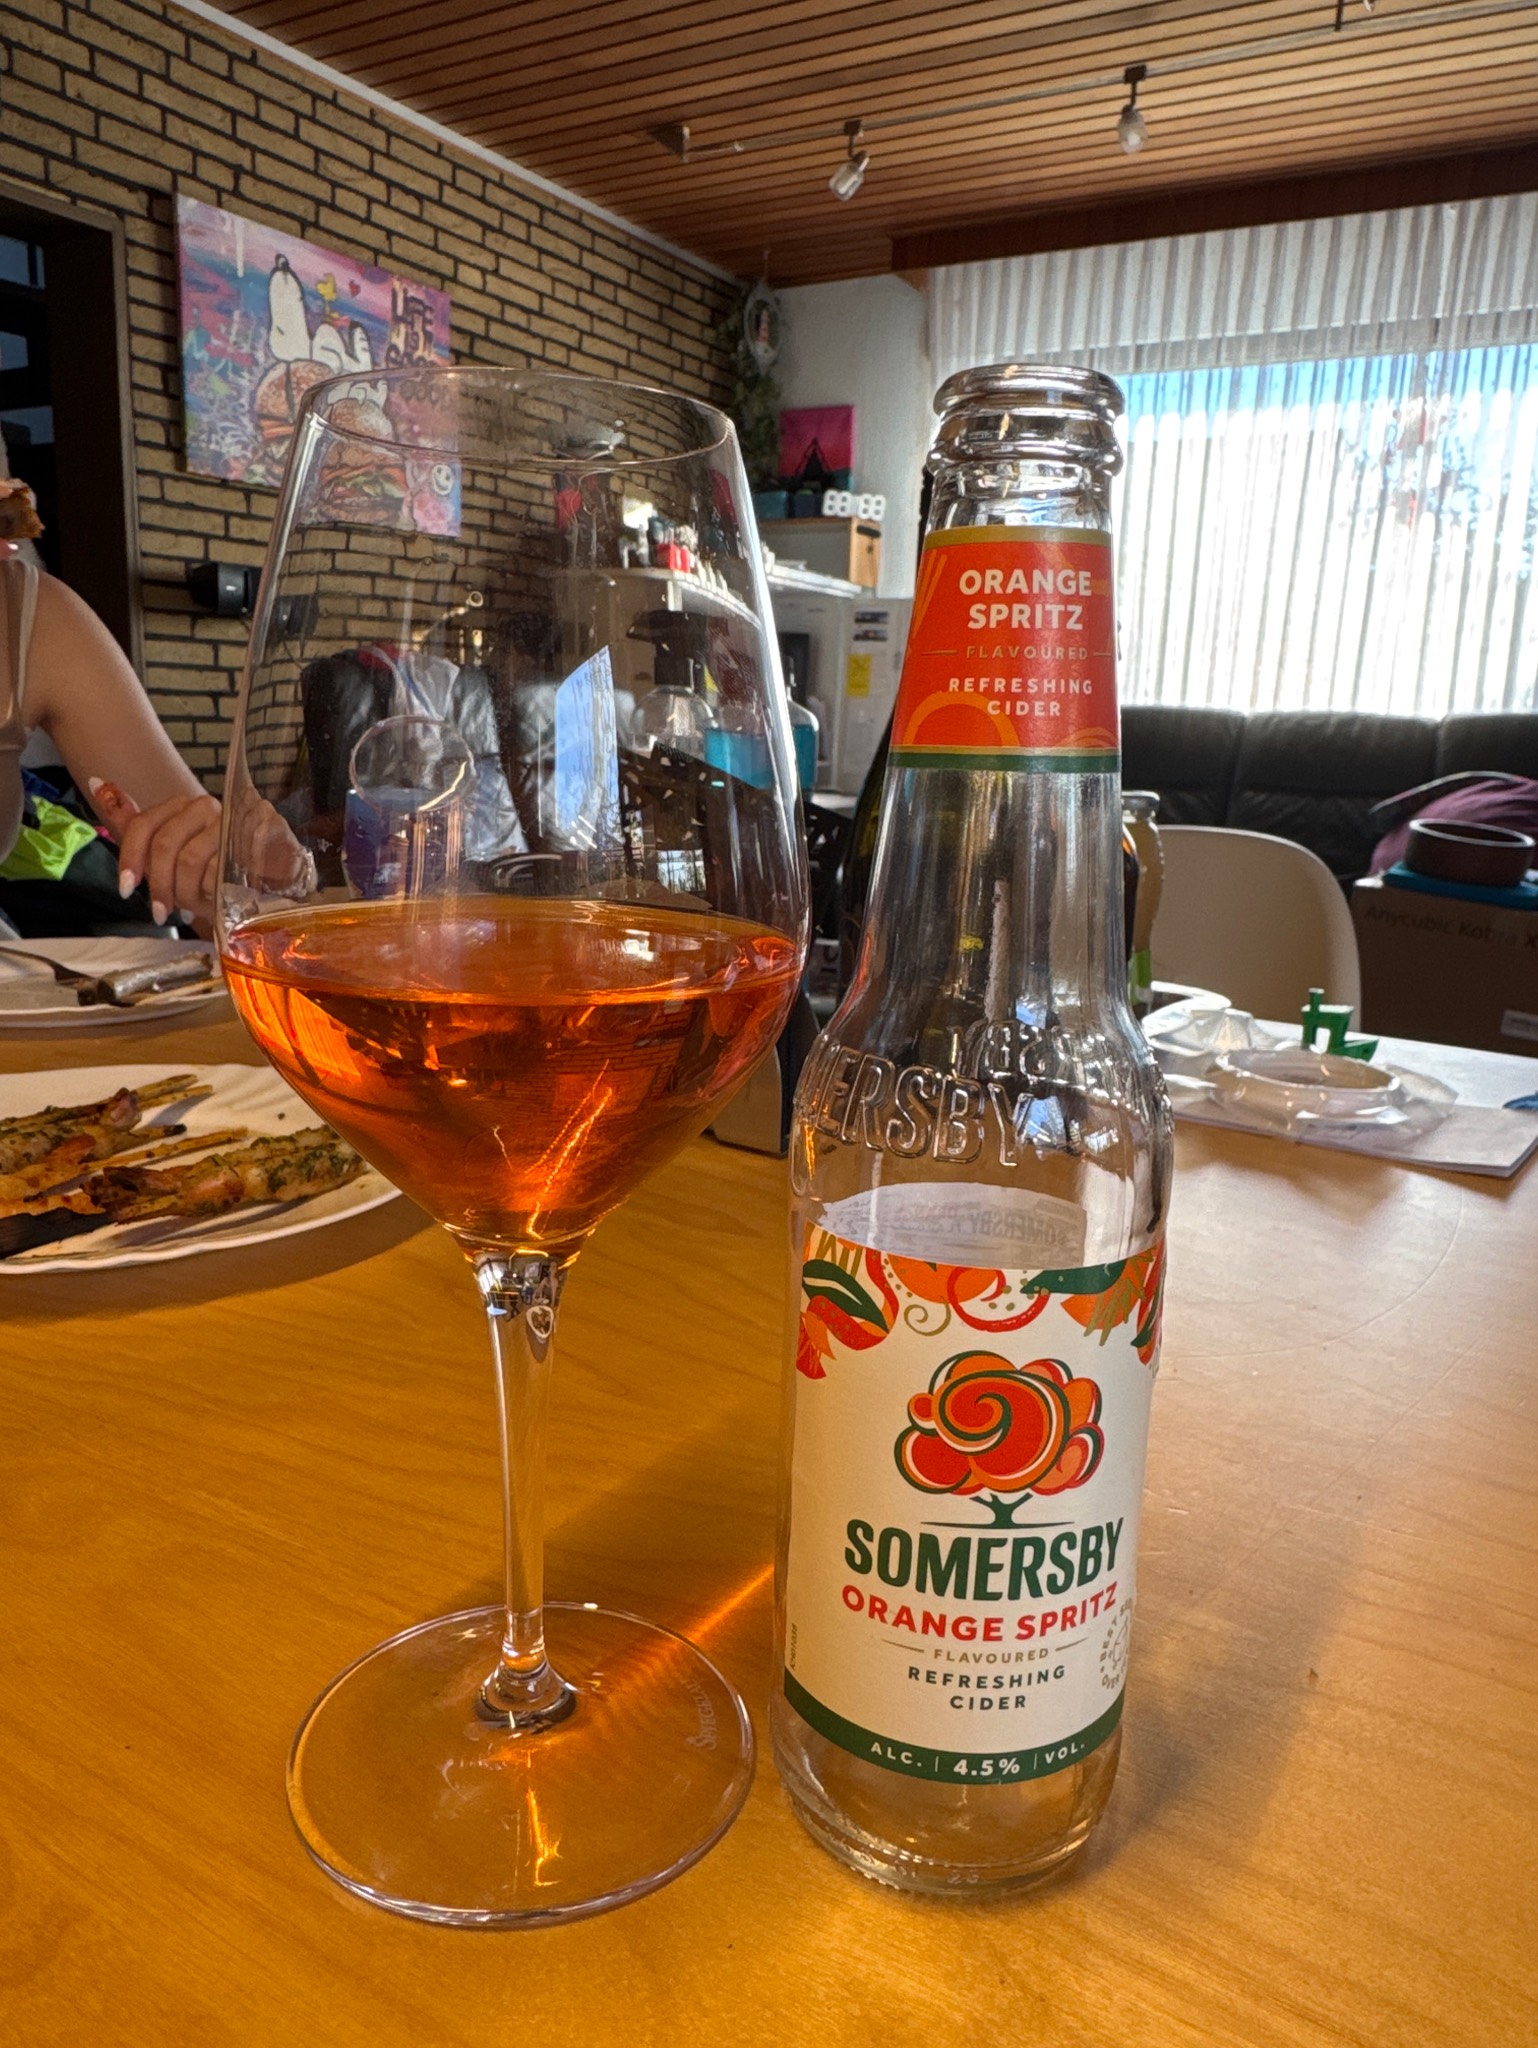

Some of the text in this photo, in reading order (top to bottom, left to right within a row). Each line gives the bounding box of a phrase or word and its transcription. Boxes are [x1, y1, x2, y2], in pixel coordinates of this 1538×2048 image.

[959, 569, 1092, 596] ORANGE
[967, 603, 1083, 630] SPRITZ
[966, 645, 1088, 661] FLAVOURED
[949, 677, 1092, 695] REFRESHING
[987, 701, 1061, 716] CIDER
[844, 1517, 1124, 1601] SOMERSBY
[842, 1581, 1118, 1642] ORANGE SPRITZ
[934, 1648, 1049, 1664] FLAVOURED
[908, 1665, 1066, 1690] REFRESHING
[949, 1695, 1027, 1711] CIDER
[870, 1741, 1085, 1776] ALC. 4.5% VOL.
